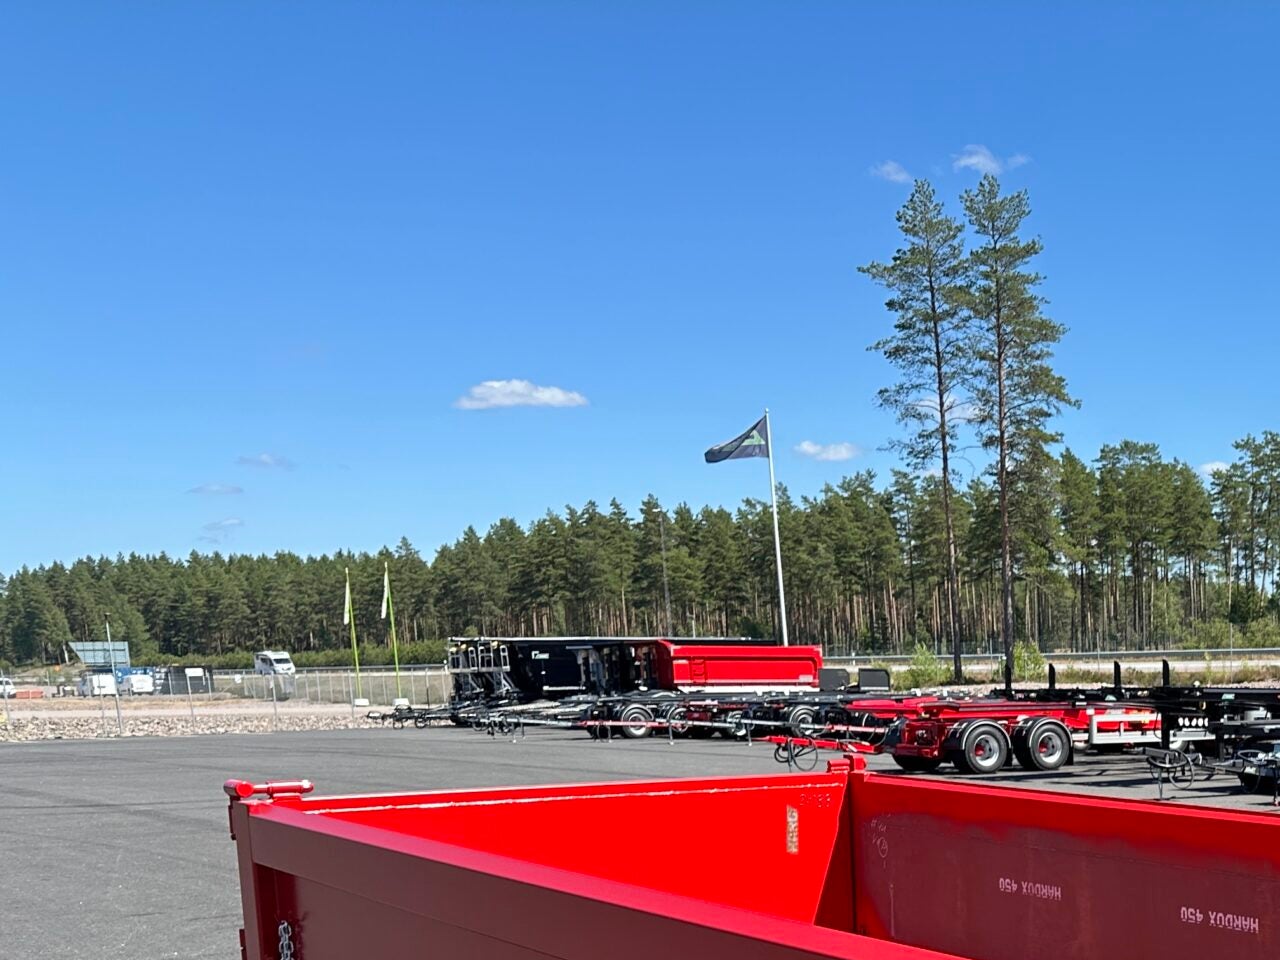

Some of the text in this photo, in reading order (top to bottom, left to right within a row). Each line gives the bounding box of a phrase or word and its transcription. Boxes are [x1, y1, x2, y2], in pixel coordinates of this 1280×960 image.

[999, 877, 1062, 901] HARDOX 450
[1180, 906, 1260, 934] HARDOX 450
